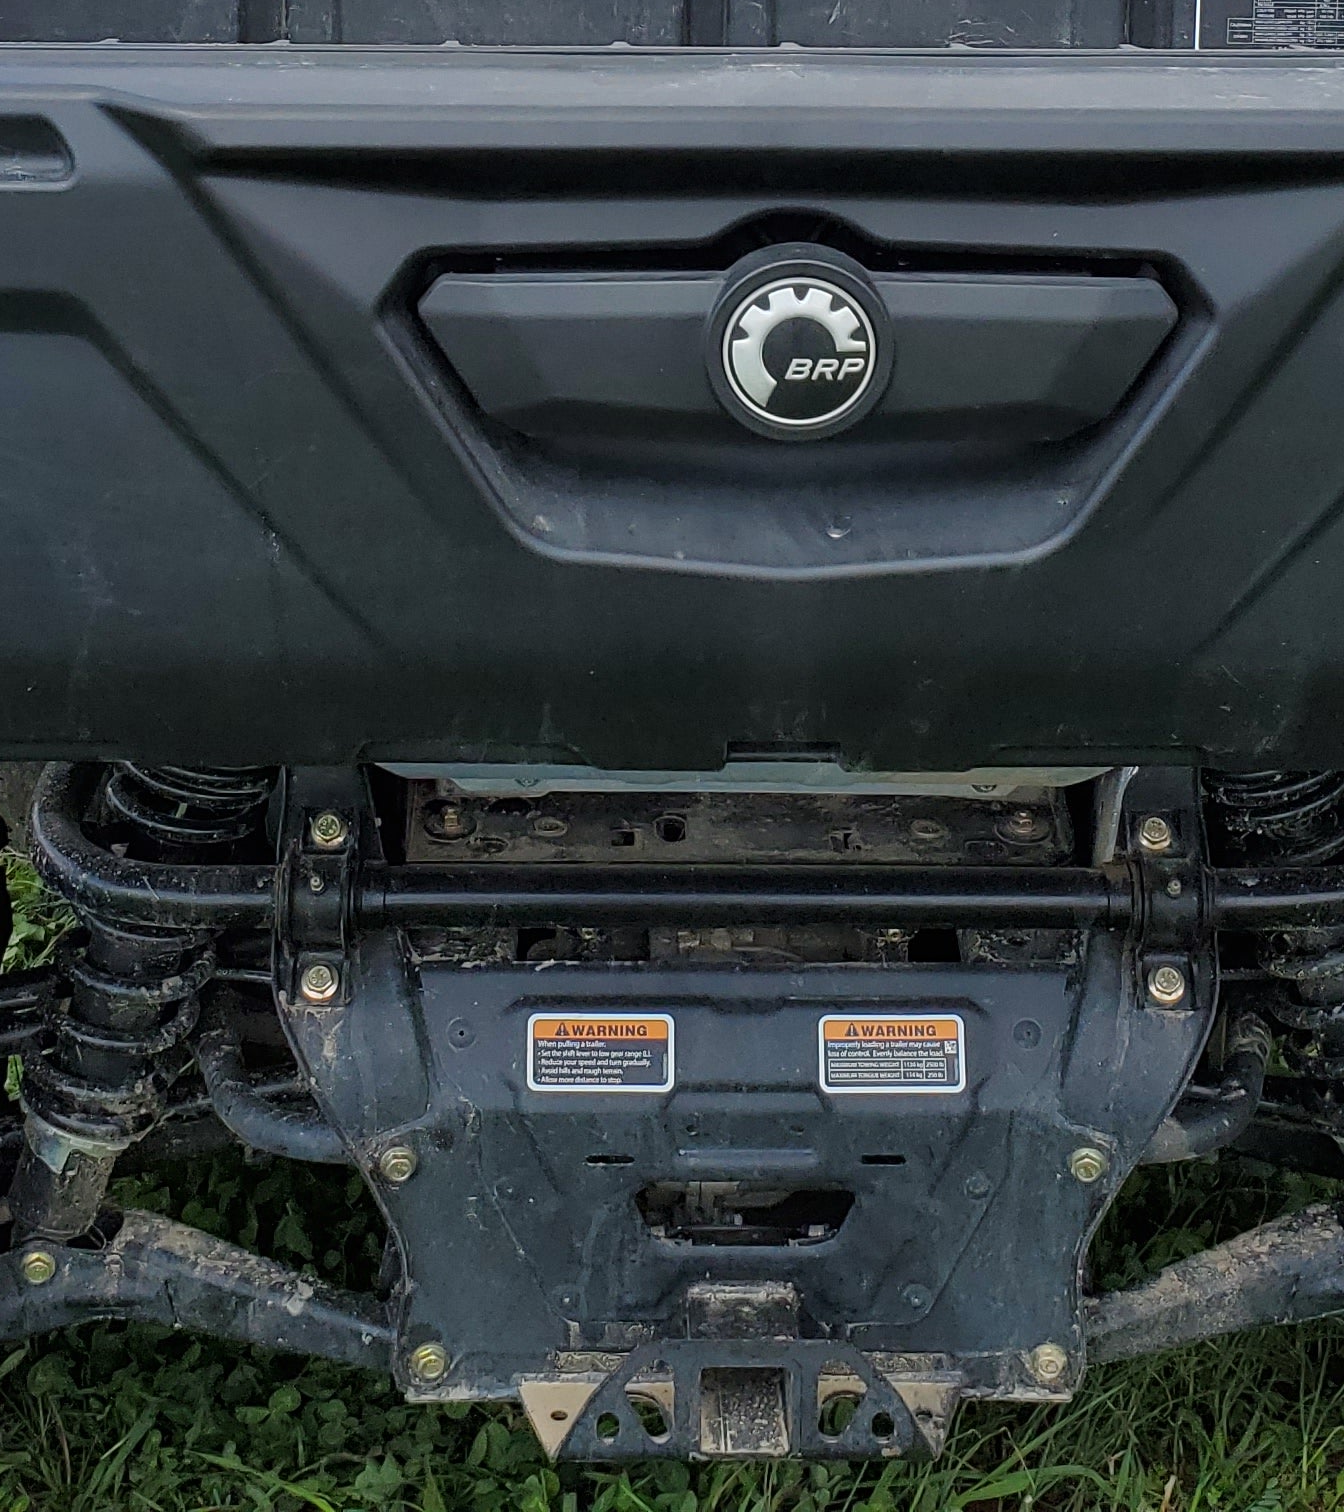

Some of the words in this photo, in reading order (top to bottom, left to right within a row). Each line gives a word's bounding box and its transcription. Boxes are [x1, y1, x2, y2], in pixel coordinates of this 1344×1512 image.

[784, 358, 865, 381] BRP
[572, 1024, 648, 1037] WARNING
[861, 1025, 937, 1037] WARNING
[537, 1040, 557, 1048] When
[551, 1049, 562, 1057] the
